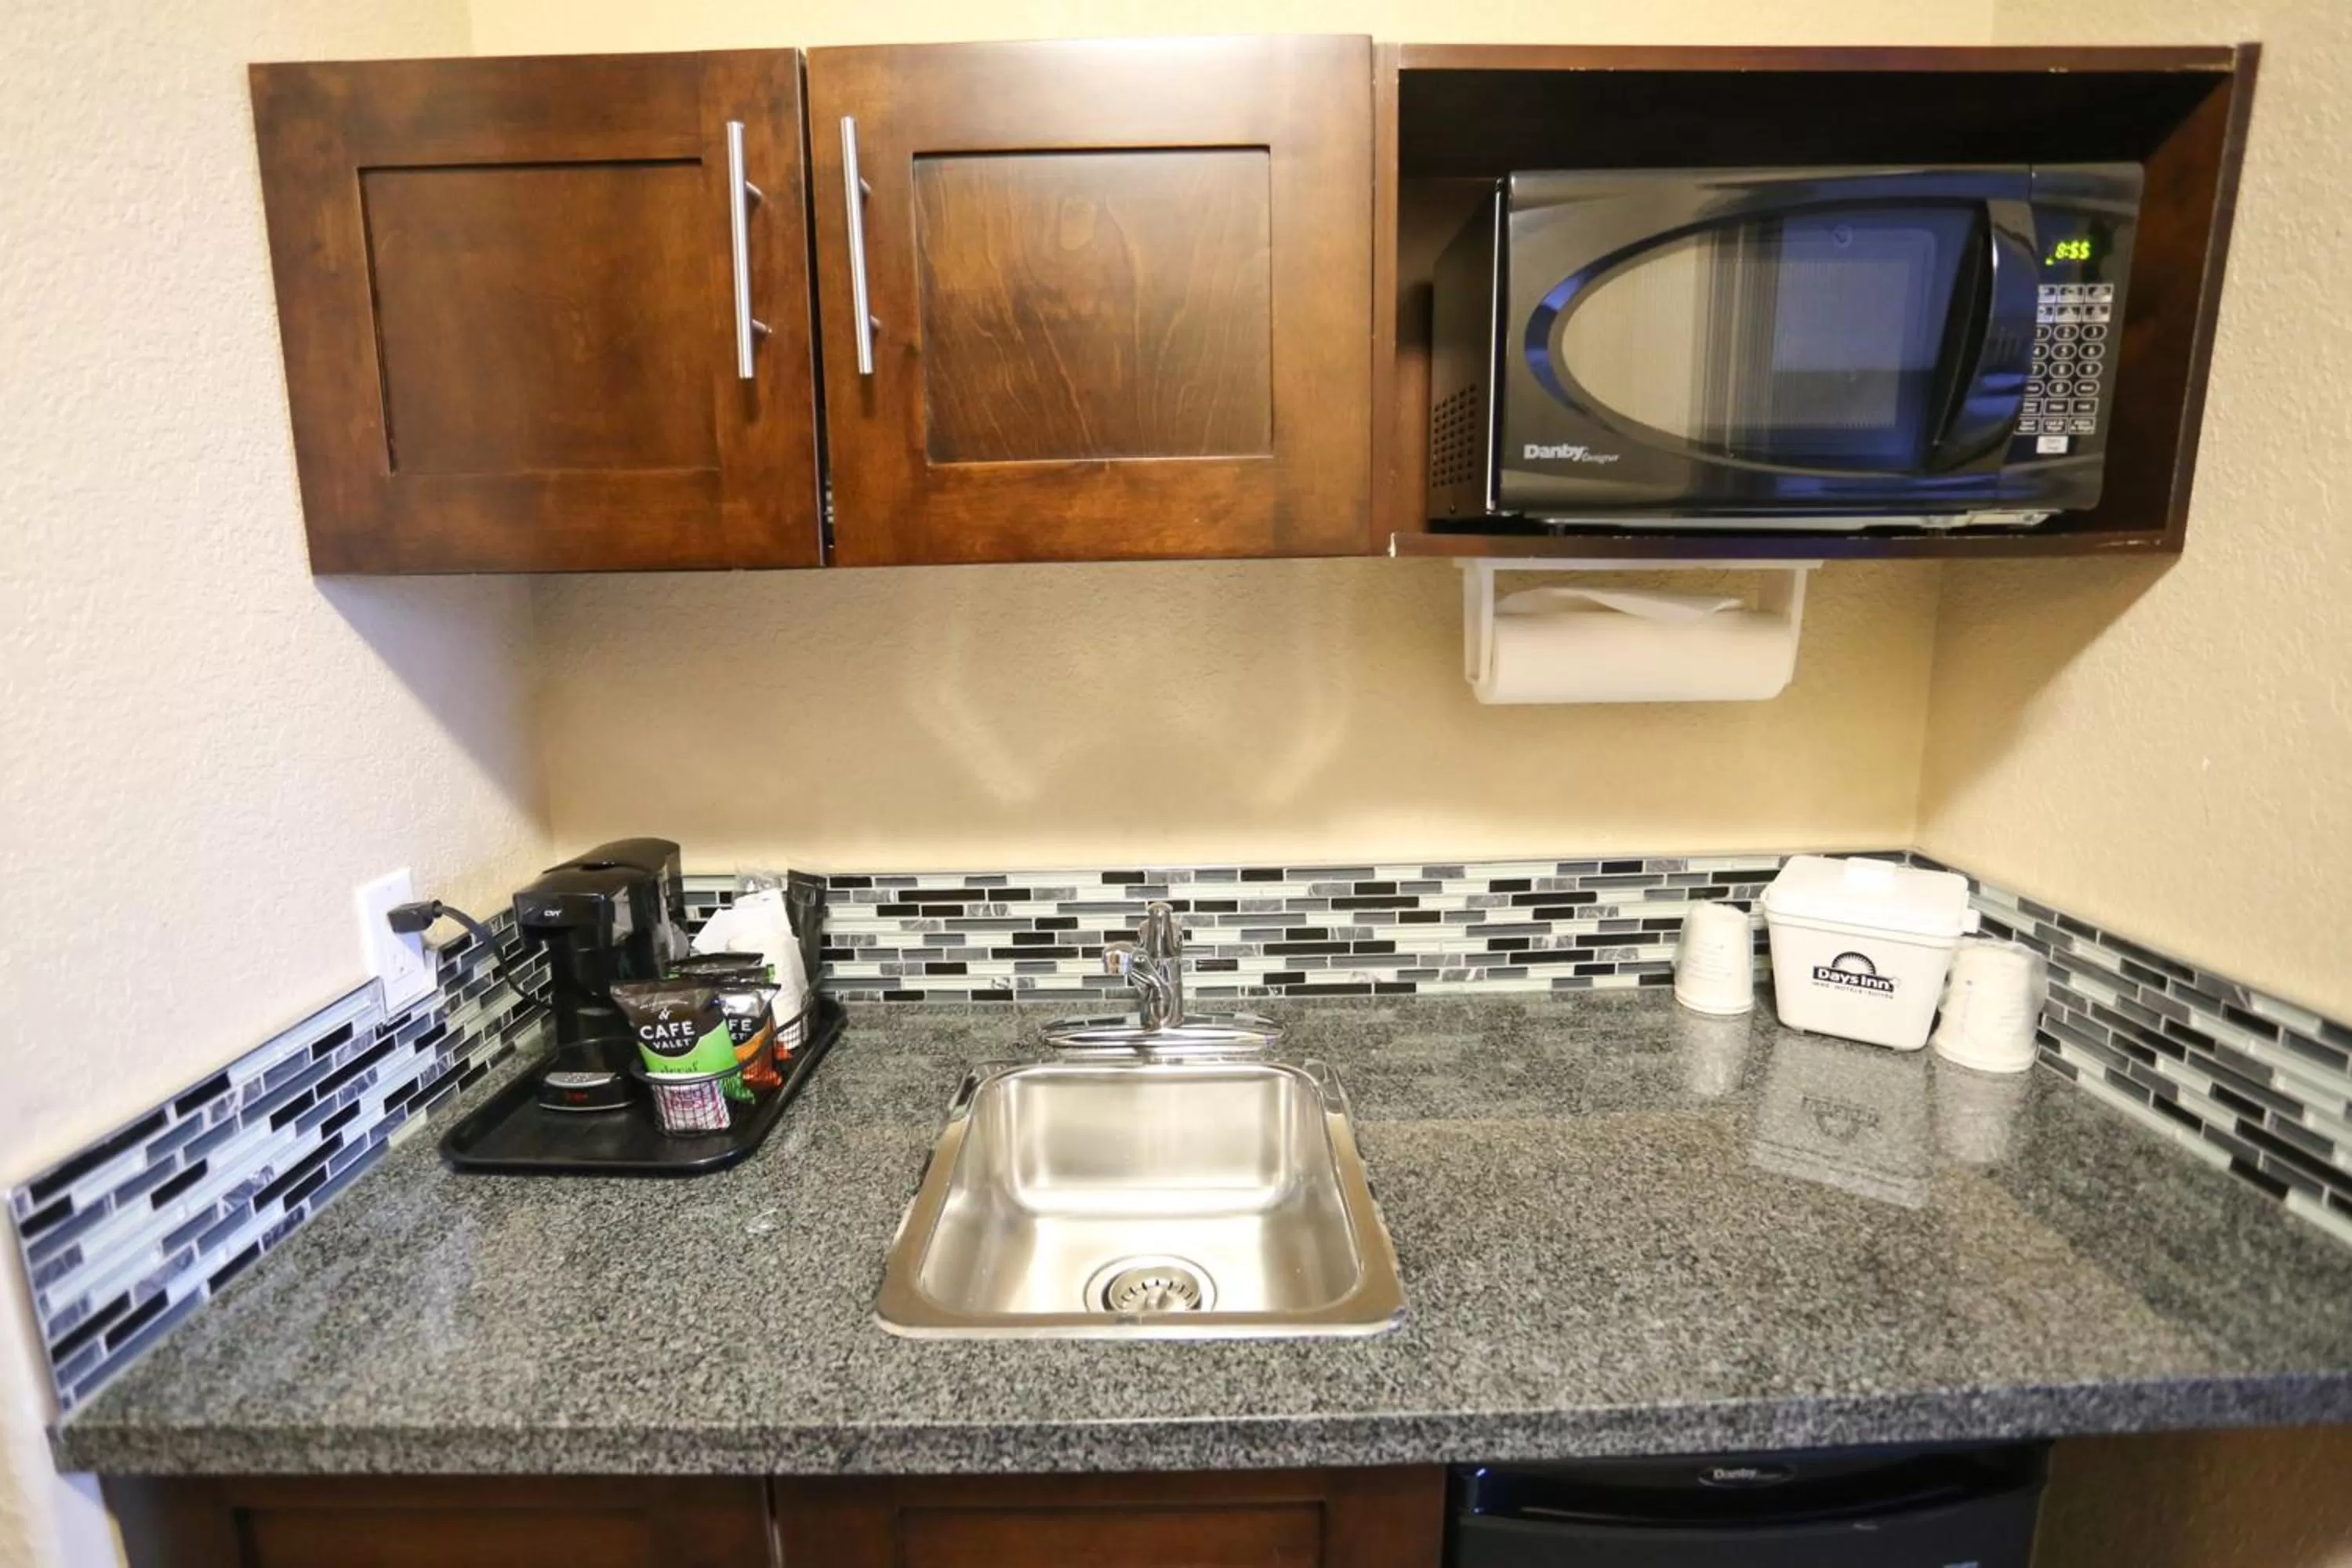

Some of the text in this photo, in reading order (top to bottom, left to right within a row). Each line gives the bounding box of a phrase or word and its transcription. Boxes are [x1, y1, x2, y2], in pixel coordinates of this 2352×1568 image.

[1523, 443, 1585, 461] Danby
[1817, 967, 1891, 990] Days Inn
[639, 1020, 695, 1040] CAFE
[728, 1018, 753, 1032] FE
[653, 1038, 691, 1050] VALET
